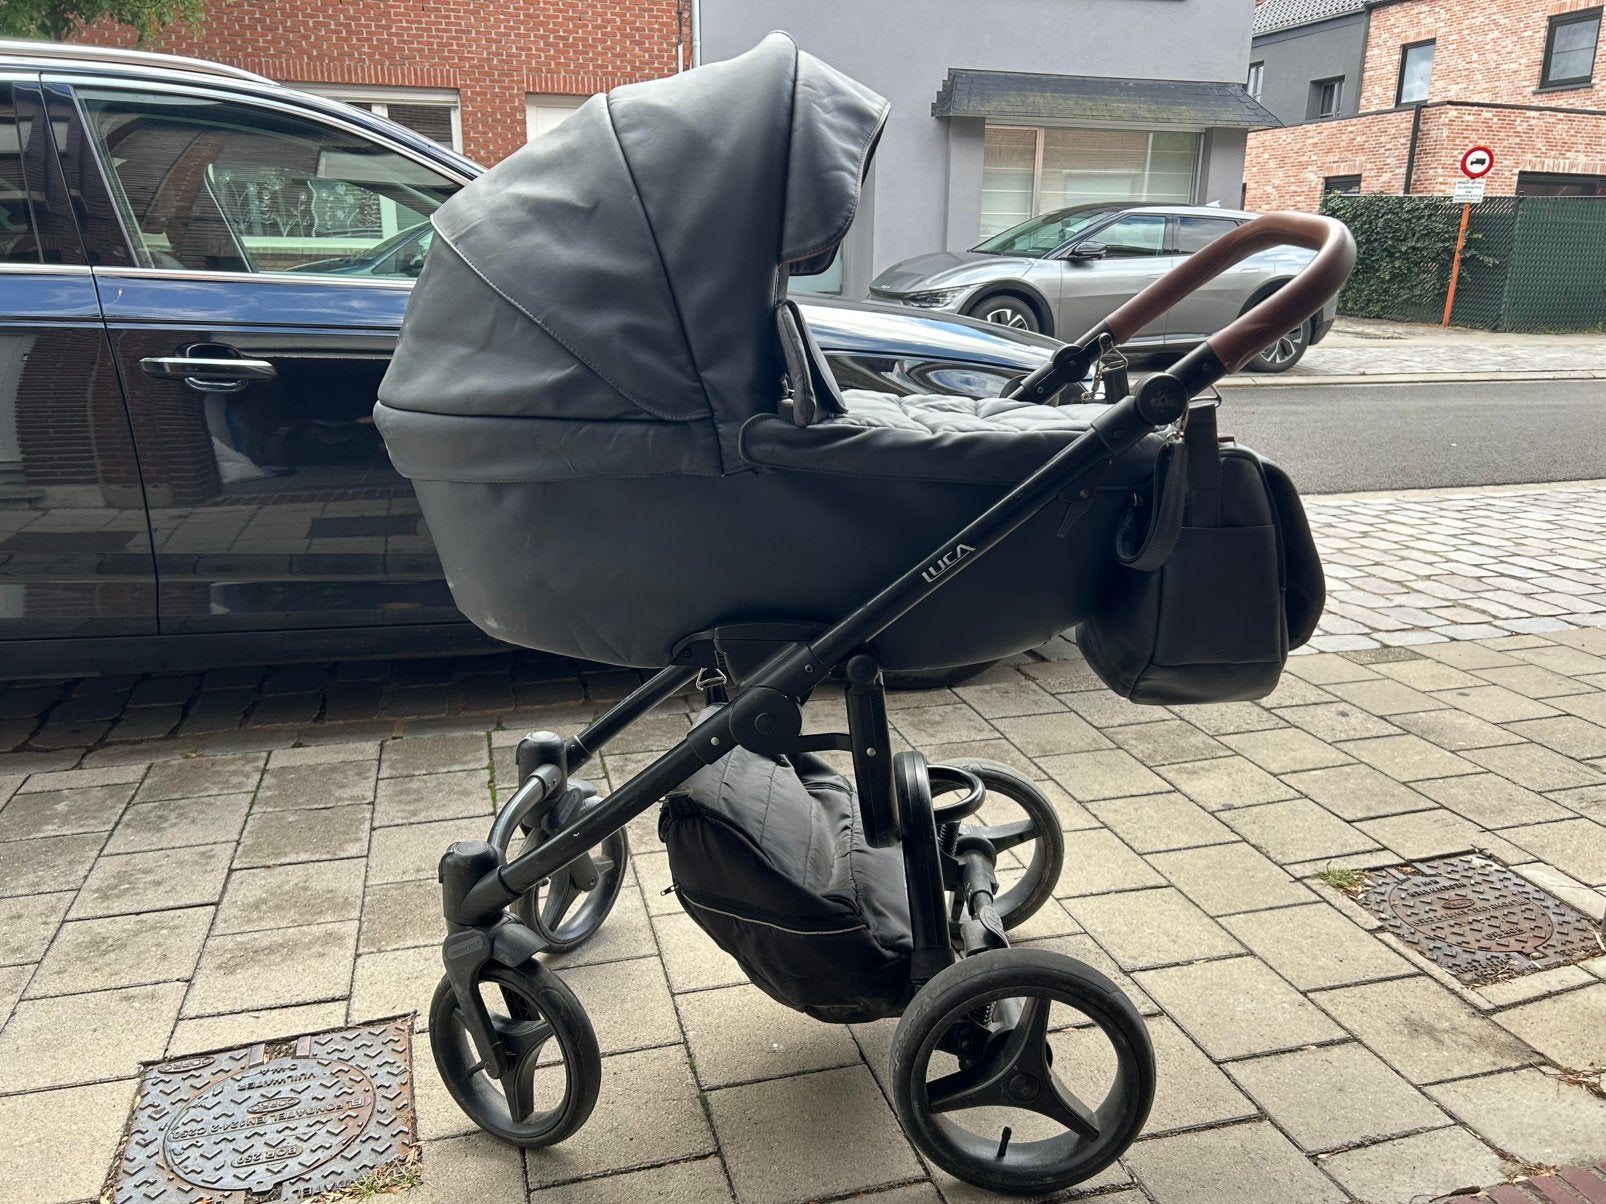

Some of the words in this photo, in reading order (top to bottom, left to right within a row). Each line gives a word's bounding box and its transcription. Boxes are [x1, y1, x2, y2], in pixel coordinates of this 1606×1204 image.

[921, 543, 976, 583] LUCA
[237, 1072, 316, 1092] VUILWATER
[250, 1098, 295, 1112] COPRO
[269, 1103, 344, 1122] FONDATEL
[236, 1153, 262, 1165] 250
[265, 1147, 297, 1160] BOR
